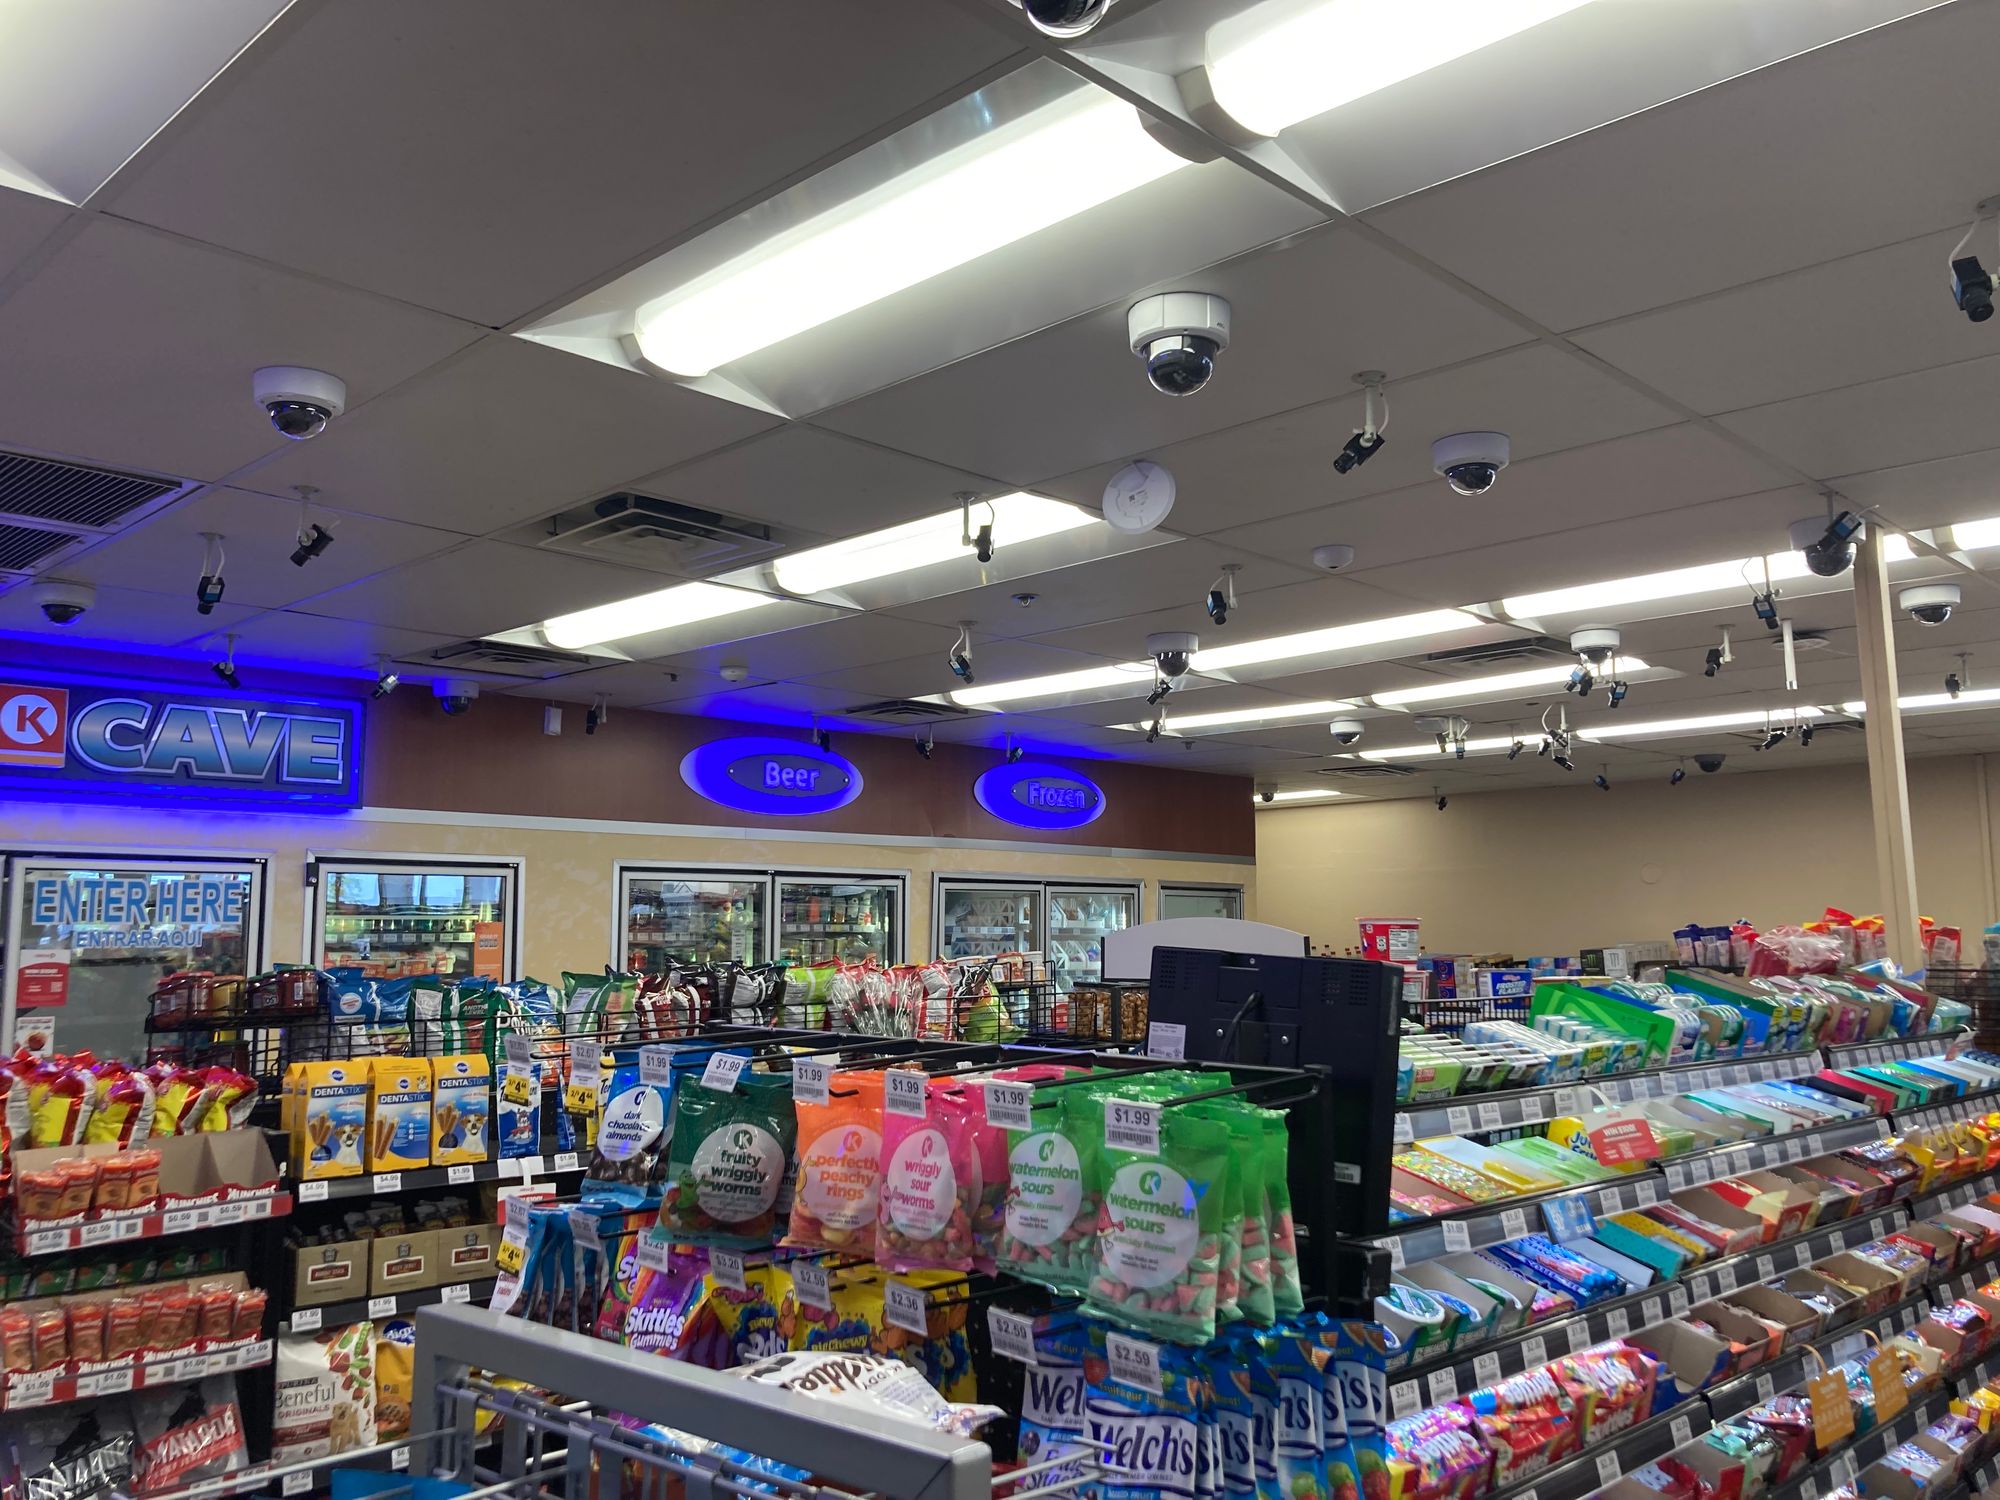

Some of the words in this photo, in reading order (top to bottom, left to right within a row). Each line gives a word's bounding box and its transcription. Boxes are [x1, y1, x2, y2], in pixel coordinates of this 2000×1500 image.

[15, 705, 50, 742] K
[71, 697, 345, 785] CAVE
[764, 760, 820, 791] Beer
[1028, 781, 1086, 808] Frozen
[33, 878, 150, 925] ENTER
[158, 880, 242, 926] HERE
[76, 930, 151, 949] ENTRAR
[646, 1055, 667, 1068] $1.99
[716, 1058, 741, 1072] $1.99
[441, 1077, 486, 1088] DENTASTIX
[798, 1068, 823, 1082] $1.99
[314, 1086, 362, 1097] DENTASTIX
[892, 1079, 920, 1094] $1.99
[380, 1093, 425, 1104] DENTASTIX
[993, 1089, 1025, 1106] $1.99
[624, 1110, 642, 1120] dark
[1114, 1107, 1151, 1126] $1.99
[606, 1130, 642, 1142] almonds
[721, 1149, 762, 1168] fruity
[815, 1155, 880, 1173] perfectly
[452, 1167, 471, 1175] $1.99
[711, 1165, 766, 1184] wriggly
[905, 1159, 942, 1179] wriggly
[304, 1183, 325, 1192] $4.99
[379, 1175, 399, 1183] $4.99
[820, 1170, 875, 1188] peachy
[910, 1178, 932, 1192] sour
[711, 1181, 761, 1196] worms
[826, 1184, 864, 1201] rings
[1021, 1181, 1055, 1195] sours
[901, 1192, 935, 1210] worms
[1110, 1193, 1196, 1220] watermelon
[1124, 1216, 1166, 1235] sours
[450, 1285, 468, 1293] $1.99
[372, 1299, 392, 1307] $1.99
[625, 1306, 685, 1337] Skittles
[996, 1317, 1027, 1339] $2.59
[630, 1333, 679, 1350] Gummies
[1114, 1344, 1151, 1366] $2.59
[278, 1403, 330, 1420] ORIGINALS
[1089, 1419, 1192, 1475] Welch's
